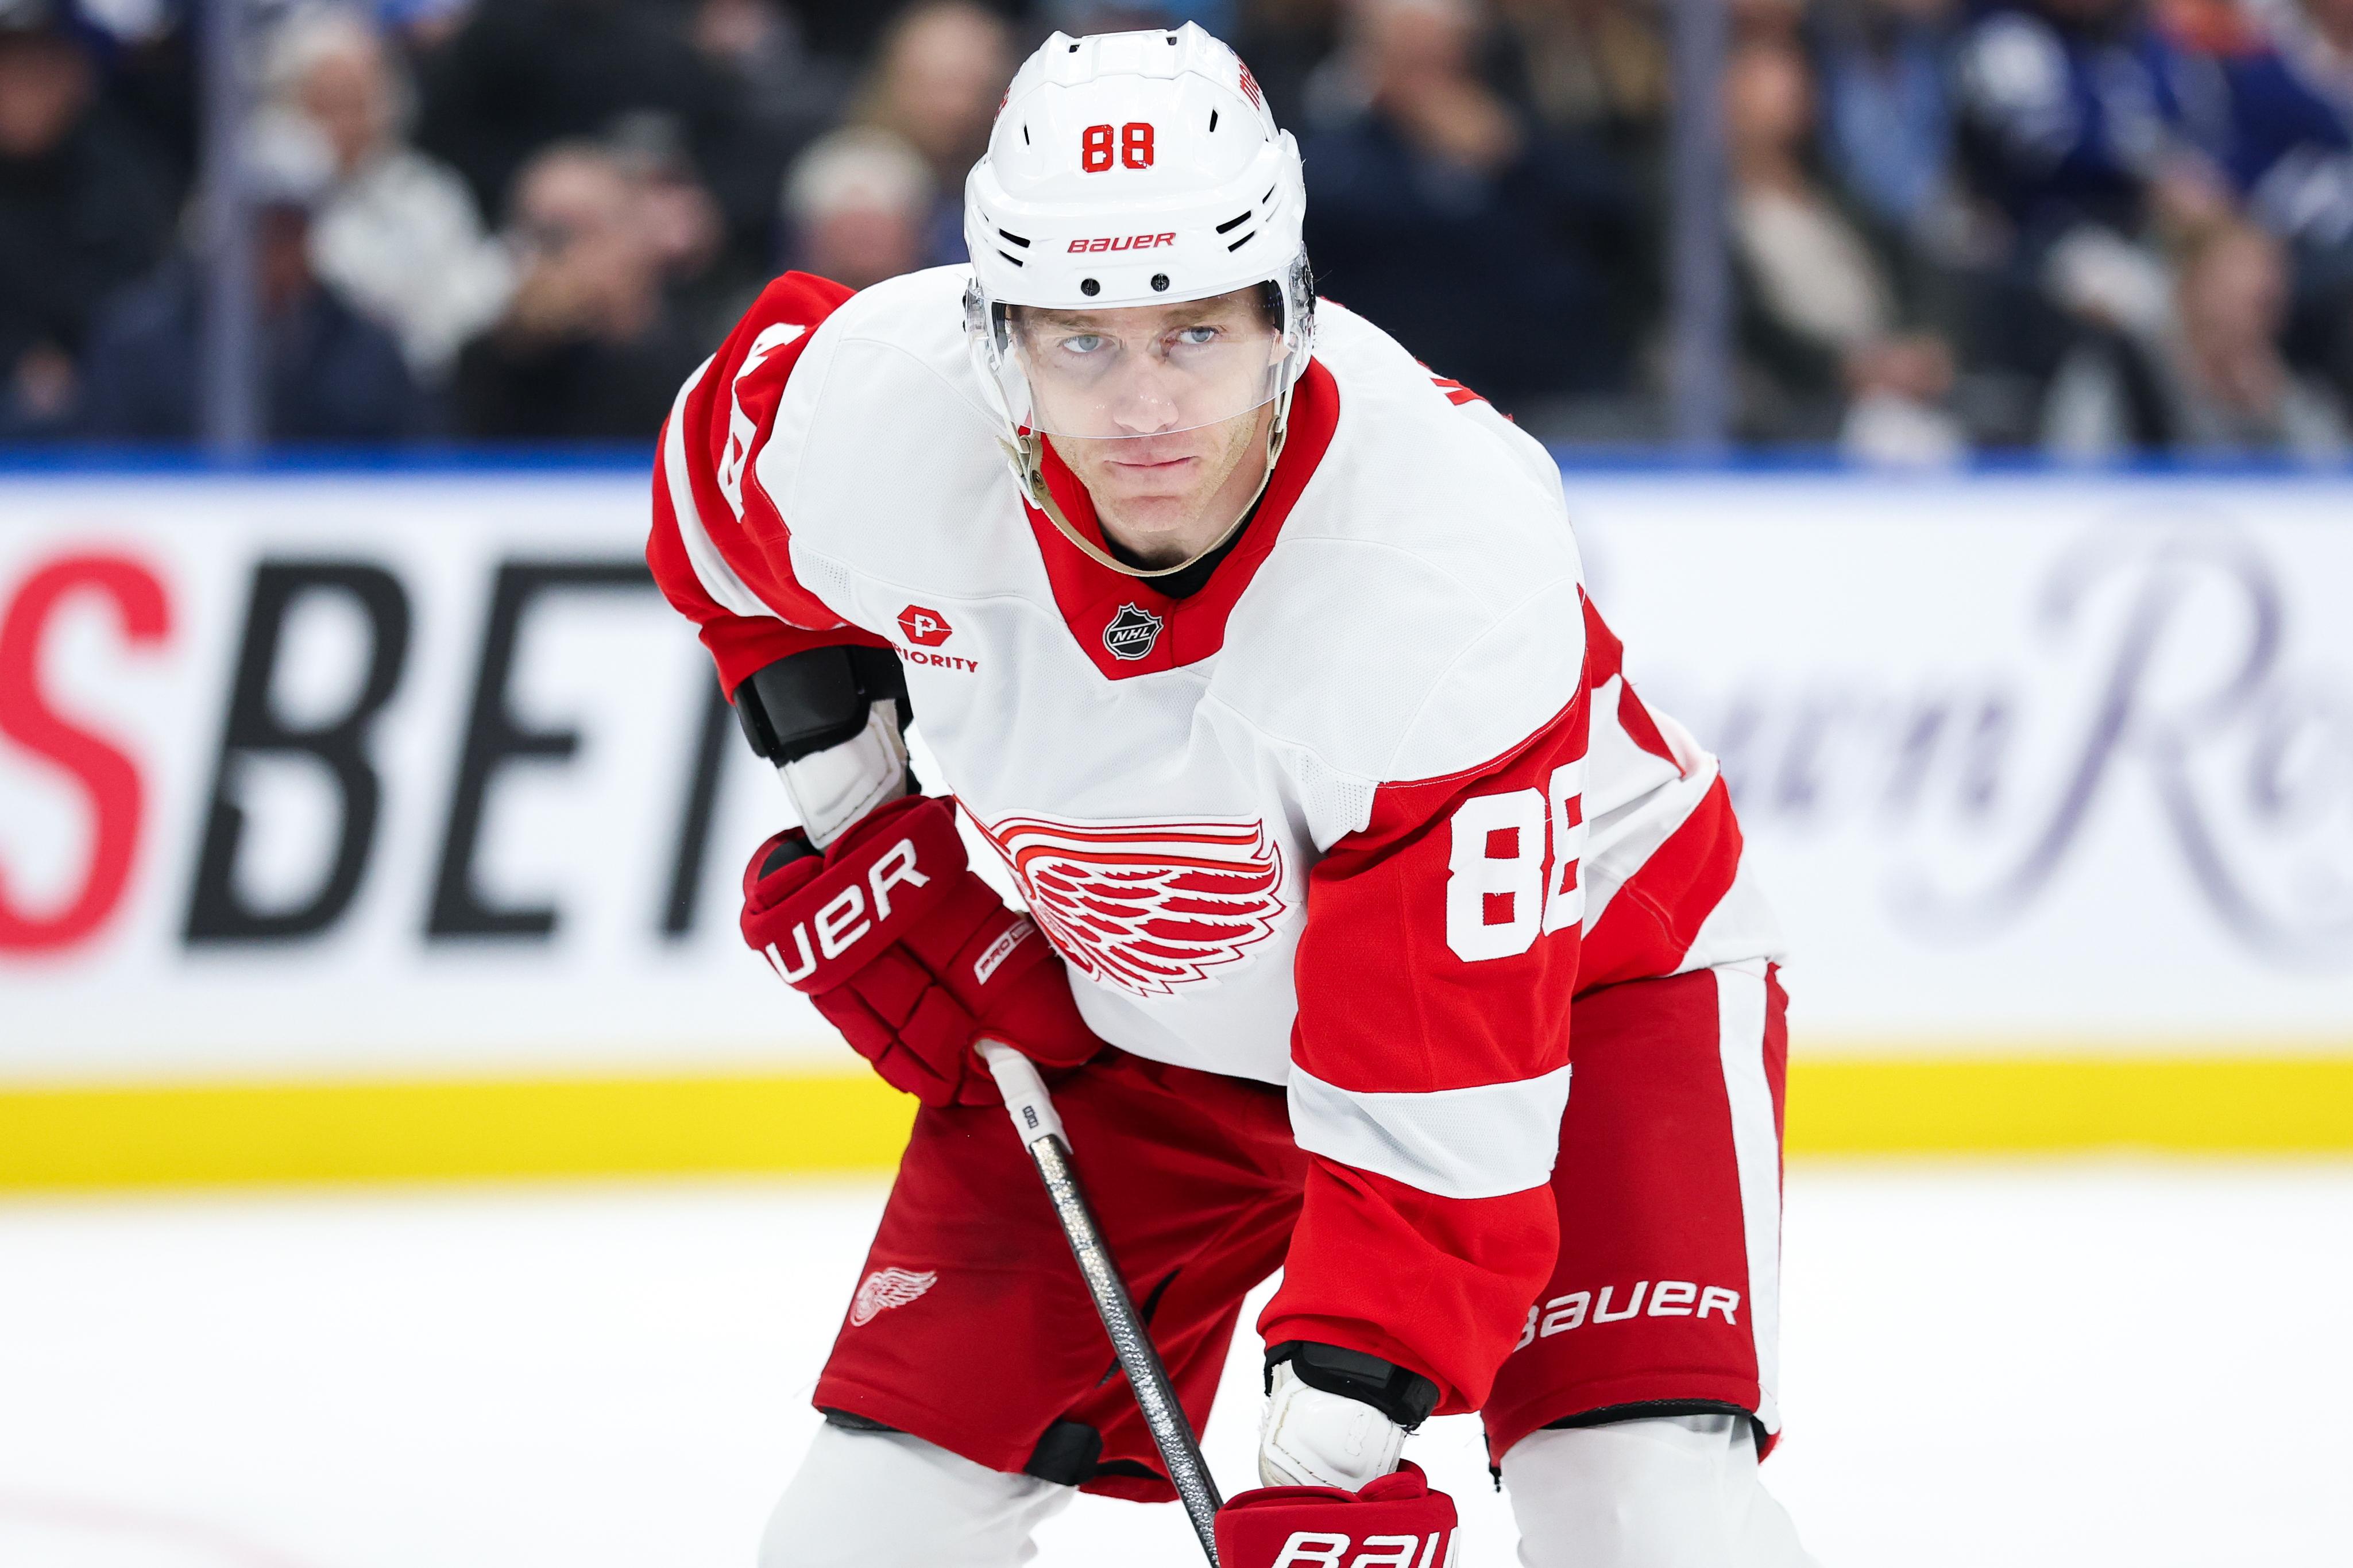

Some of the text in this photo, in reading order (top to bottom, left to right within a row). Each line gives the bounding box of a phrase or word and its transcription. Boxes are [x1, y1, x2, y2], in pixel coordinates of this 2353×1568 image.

[1082, 122, 1154, 173] 88
[1067, 232, 1176, 253] BAUER
[1112, 626, 1150, 642] NHL
[1446, 754, 1590, 963] 88
